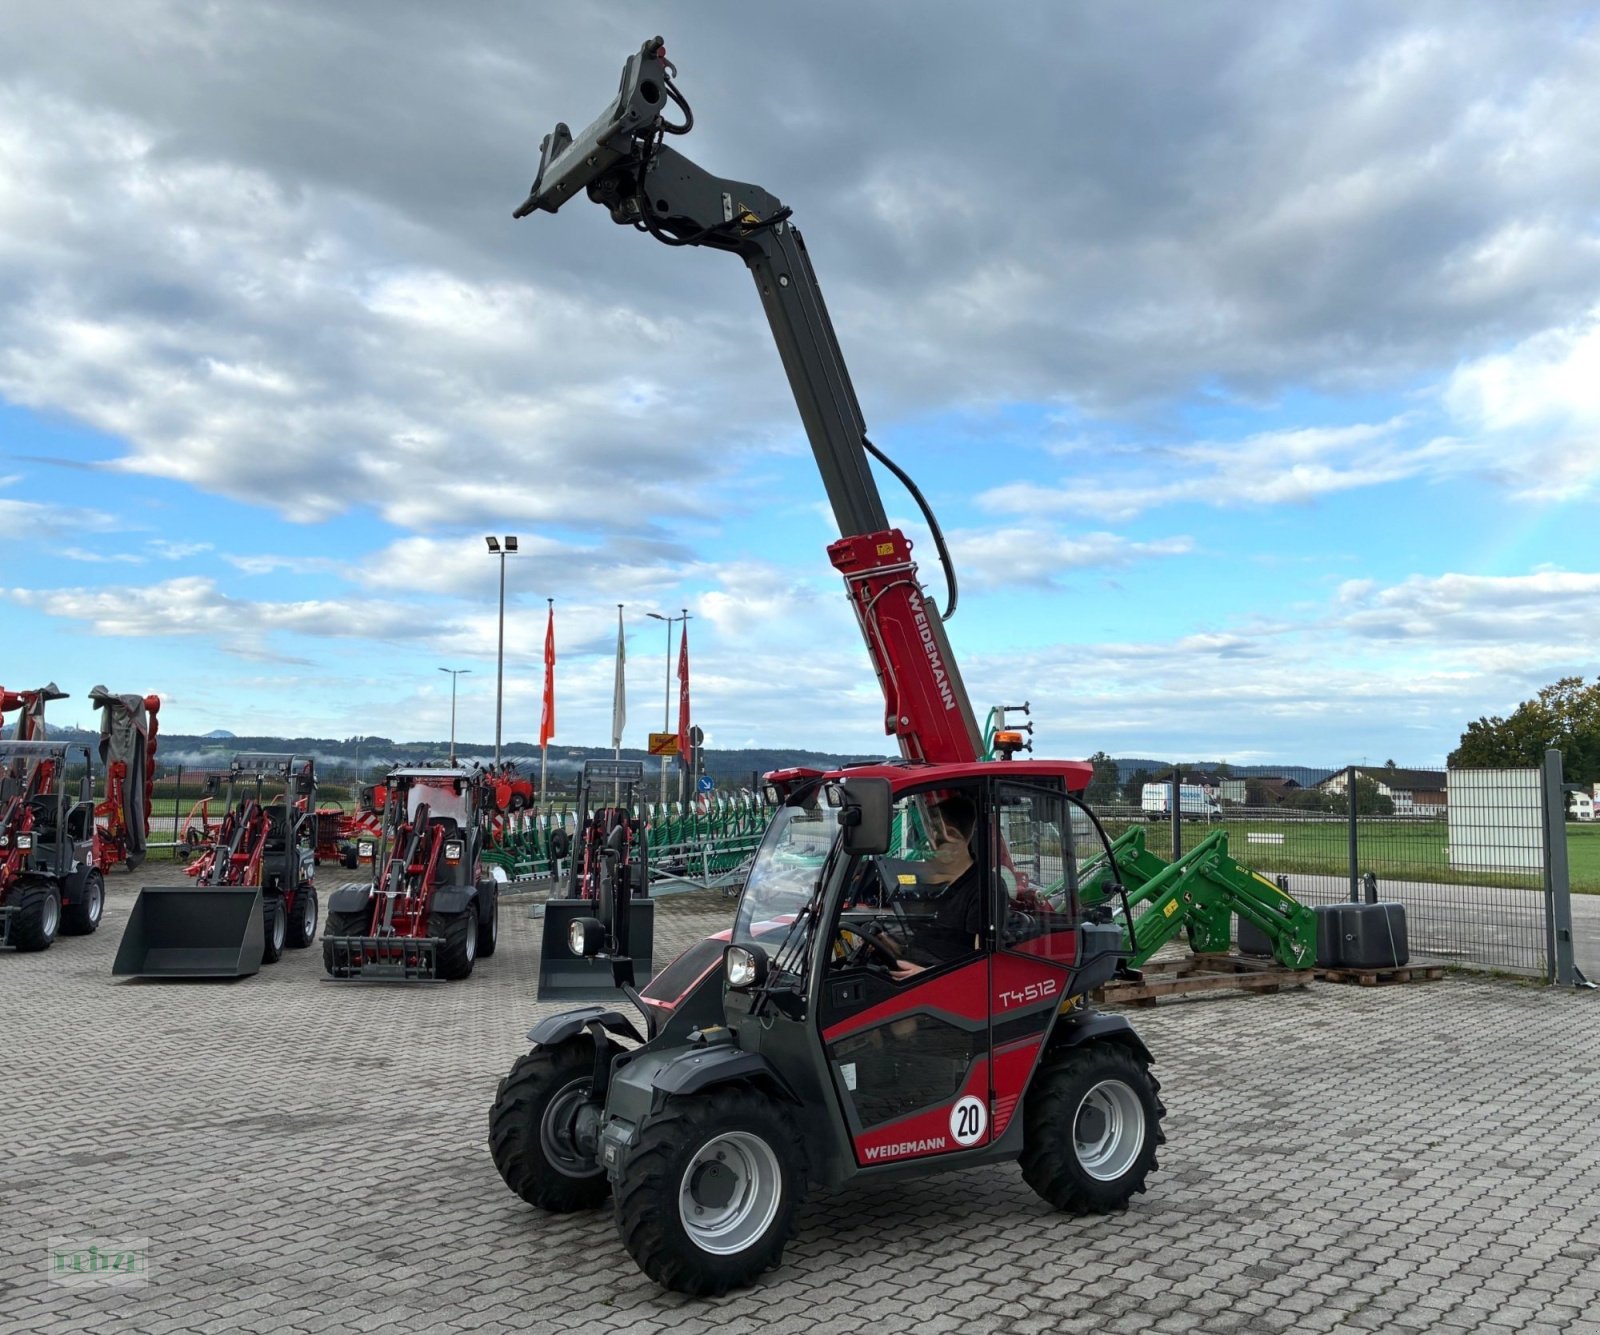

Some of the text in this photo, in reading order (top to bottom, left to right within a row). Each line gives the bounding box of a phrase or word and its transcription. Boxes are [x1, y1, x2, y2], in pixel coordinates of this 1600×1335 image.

[908, 589, 956, 711] WEIDEMANN
[999, 979, 1057, 1007] T4512
[957, 1104, 979, 1138] 20
[865, 1136, 946, 1160] WEIDEMANN
